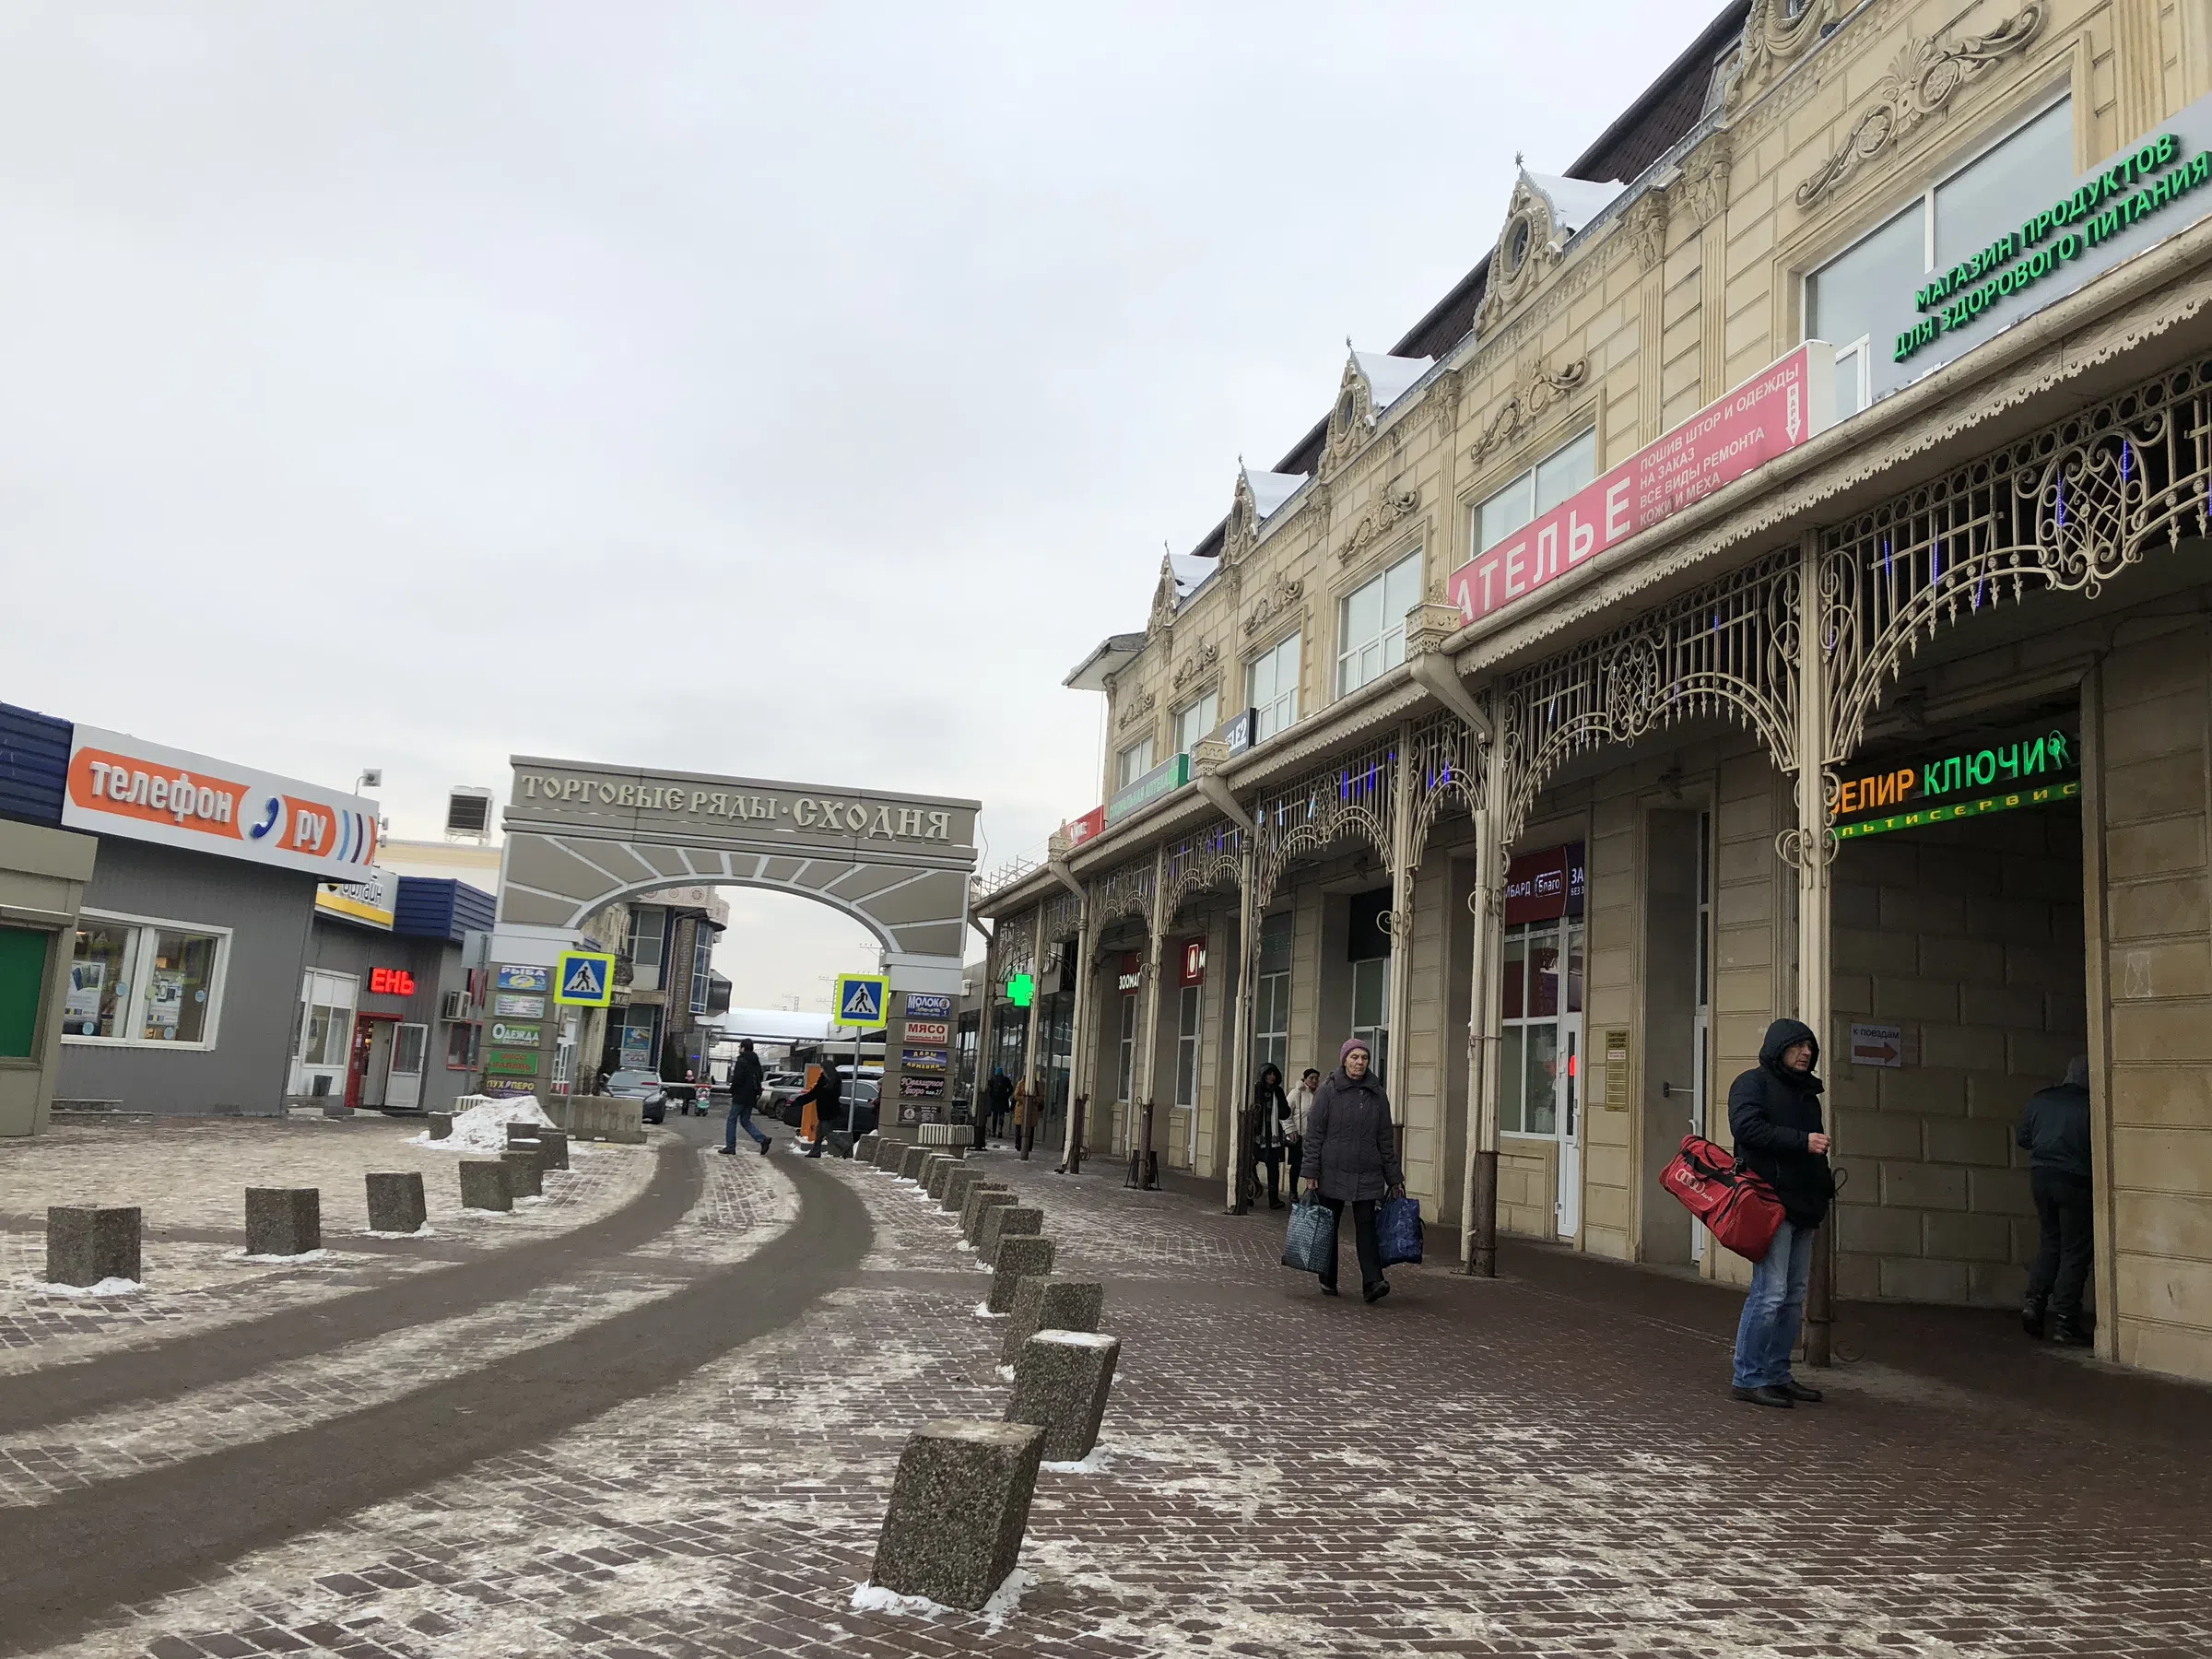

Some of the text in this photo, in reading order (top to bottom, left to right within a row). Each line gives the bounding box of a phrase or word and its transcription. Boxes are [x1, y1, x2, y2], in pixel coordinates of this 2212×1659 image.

[1914, 134, 2177, 312] МАГАЗИН ПРОДУКТОВ
[1893, 150, 2212, 361] ДЛЯ ЗДОРОВОГО ПИТАНИЯ
[1640, 363, 1799, 472] ПОШИВ ШТОР И ОДЕЖДЫ
[1640, 426, 1765, 509] ВСЕ ВИДЫ РЕМОНТА
[1640, 447, 1695, 491] НА ЗАКАЗ
[1640, 472, 1721, 527] КОЖИ И МЕХА
[1457, 476, 1630, 621] АТЕЛЬЕ
[1832, 737, 2045, 814] ЕЛИР КЛЮЧИ
[89, 761, 327, 851] телефон ру
[688, 791, 779, 821] РЯДЫ
[793, 797, 952, 841] СХОДНЯ
[1841, 782, 2077, 837] ЛЬТИСЕРВИС
[1538, 878, 1560, 893] Благо
[500, 967, 546, 977] РЫБА
[908, 1023, 946, 1034] МЯСО
[1860, 1029, 1900, 1039] поездам
[486, 1079, 535, 1091] ПУХ ПЕРО
